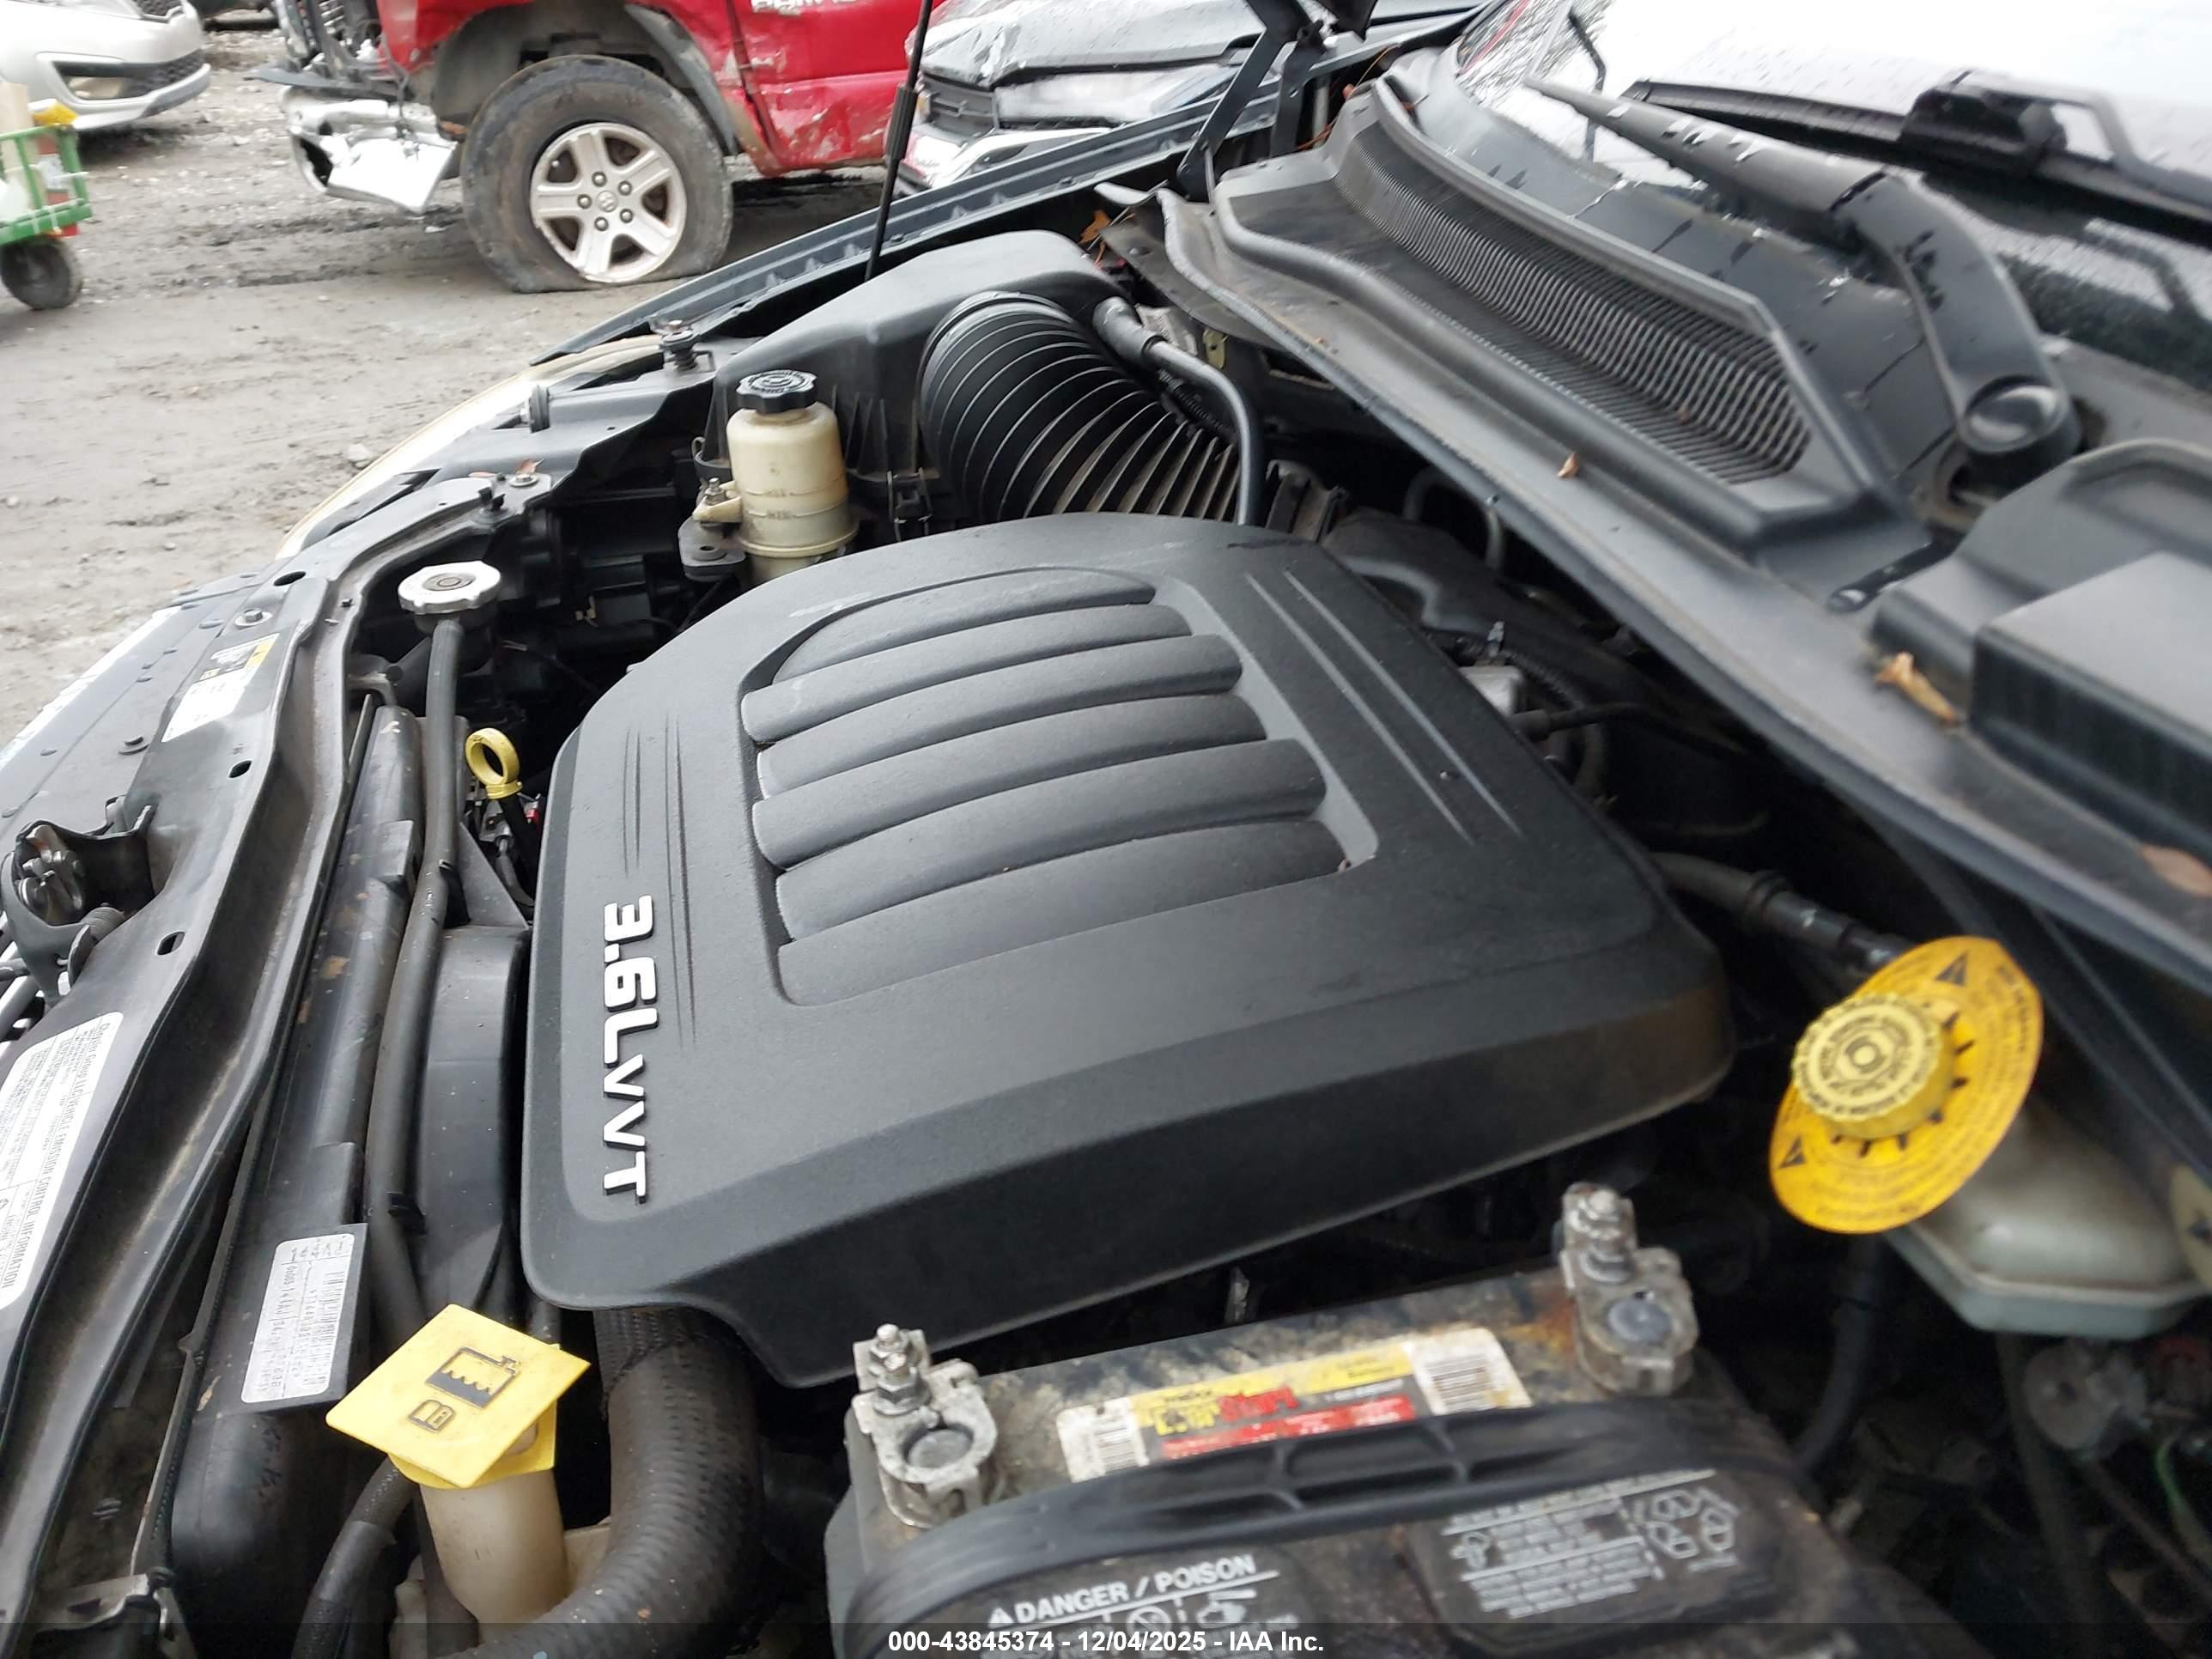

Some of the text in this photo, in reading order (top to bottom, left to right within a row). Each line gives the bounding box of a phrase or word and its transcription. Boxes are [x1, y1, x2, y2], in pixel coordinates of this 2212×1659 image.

[88, 1022, 110, 1054] Chrysler
[76, 1054, 97, 1079] Group
[58, 1096, 82, 1132] VEHICLE
[41, 1133, 67, 1175] EMISSION
[26, 1176, 52, 1219] CONTROL
[1, 1220, 35, 1289] INFORMATION
[1013, 1581, 1129, 1624] DANGER
[1154, 1553, 1257, 1593] POISON
